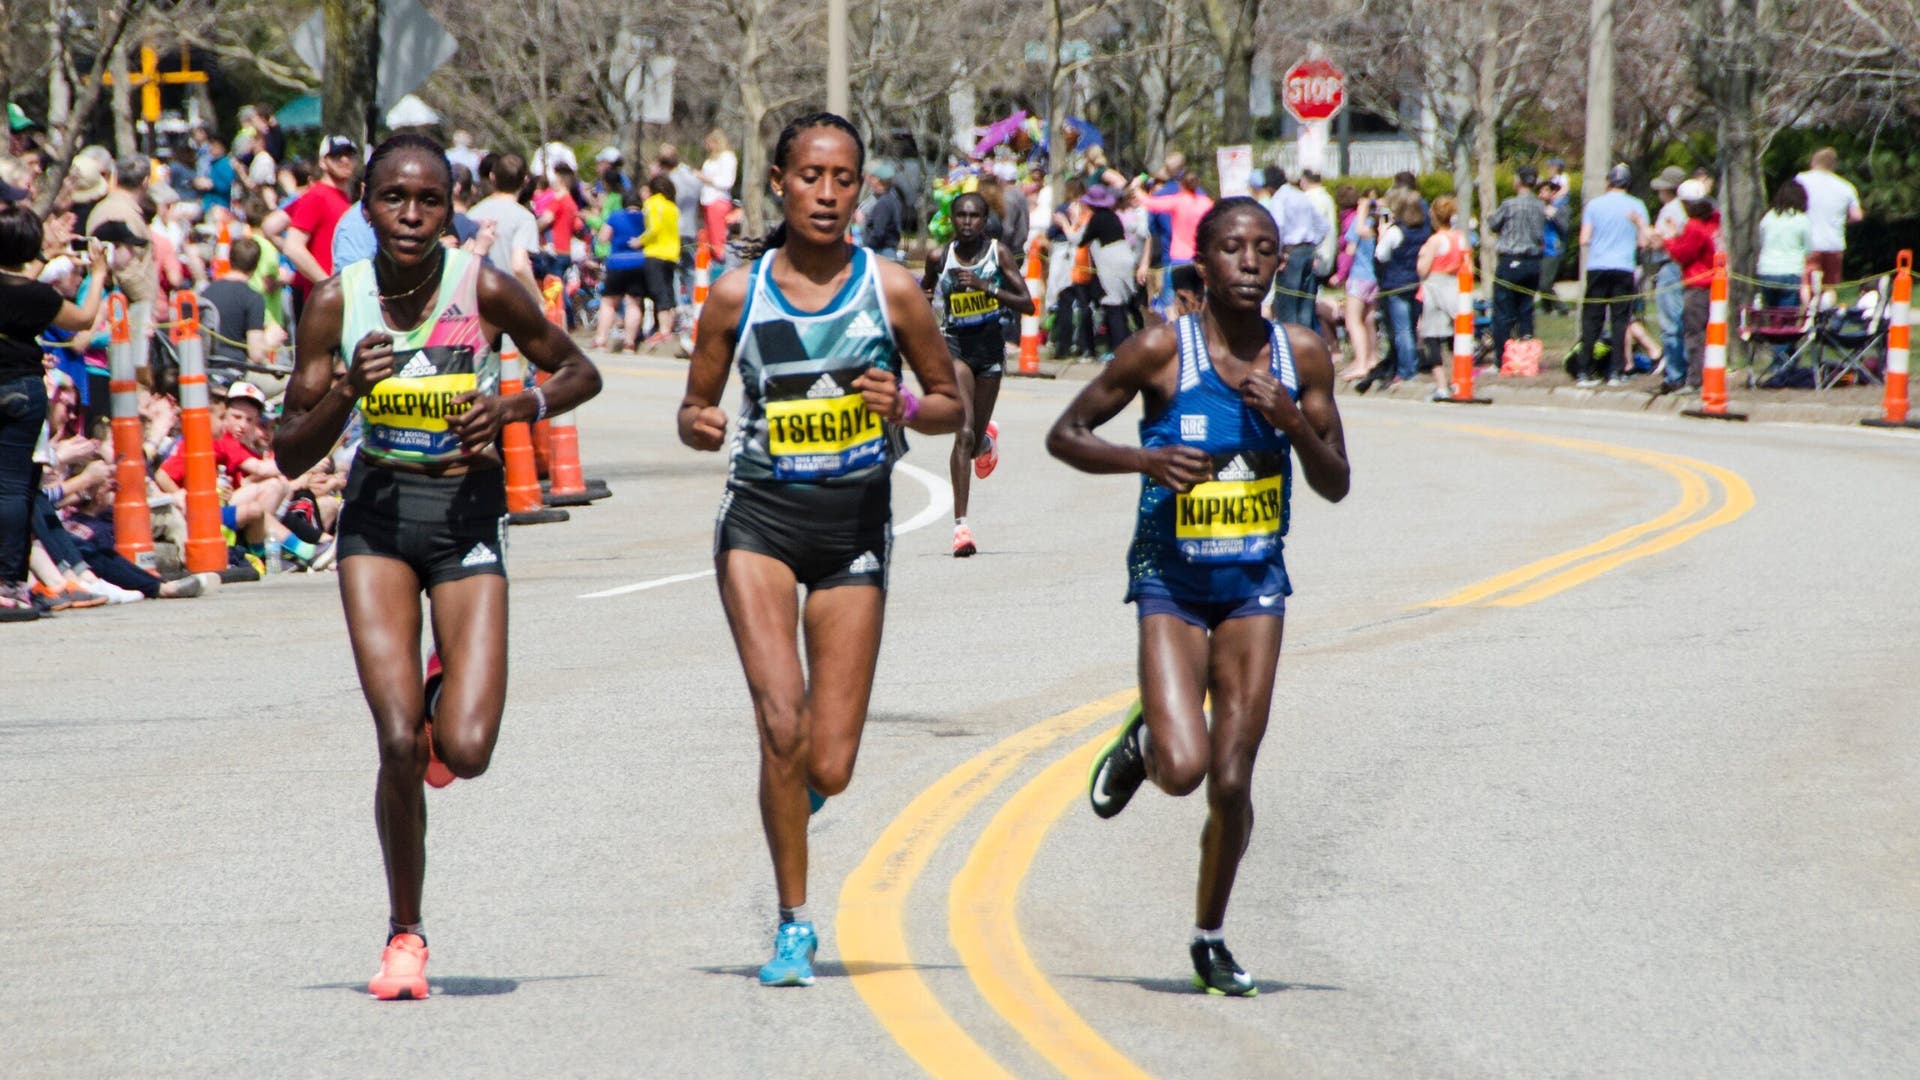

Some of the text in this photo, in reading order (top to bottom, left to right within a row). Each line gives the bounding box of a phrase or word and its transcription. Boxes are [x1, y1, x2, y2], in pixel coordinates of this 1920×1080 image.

[1289, 77, 1341, 103] STOP
[399, 365, 438, 377] adidas
[806, 386, 845, 399] adidas
[1218, 470, 1255, 481] adidas
[1181, 488, 1279, 526] KIPKETER
[1201, 546, 1243, 555] MARATHON
[462, 553, 497, 567] adidas
